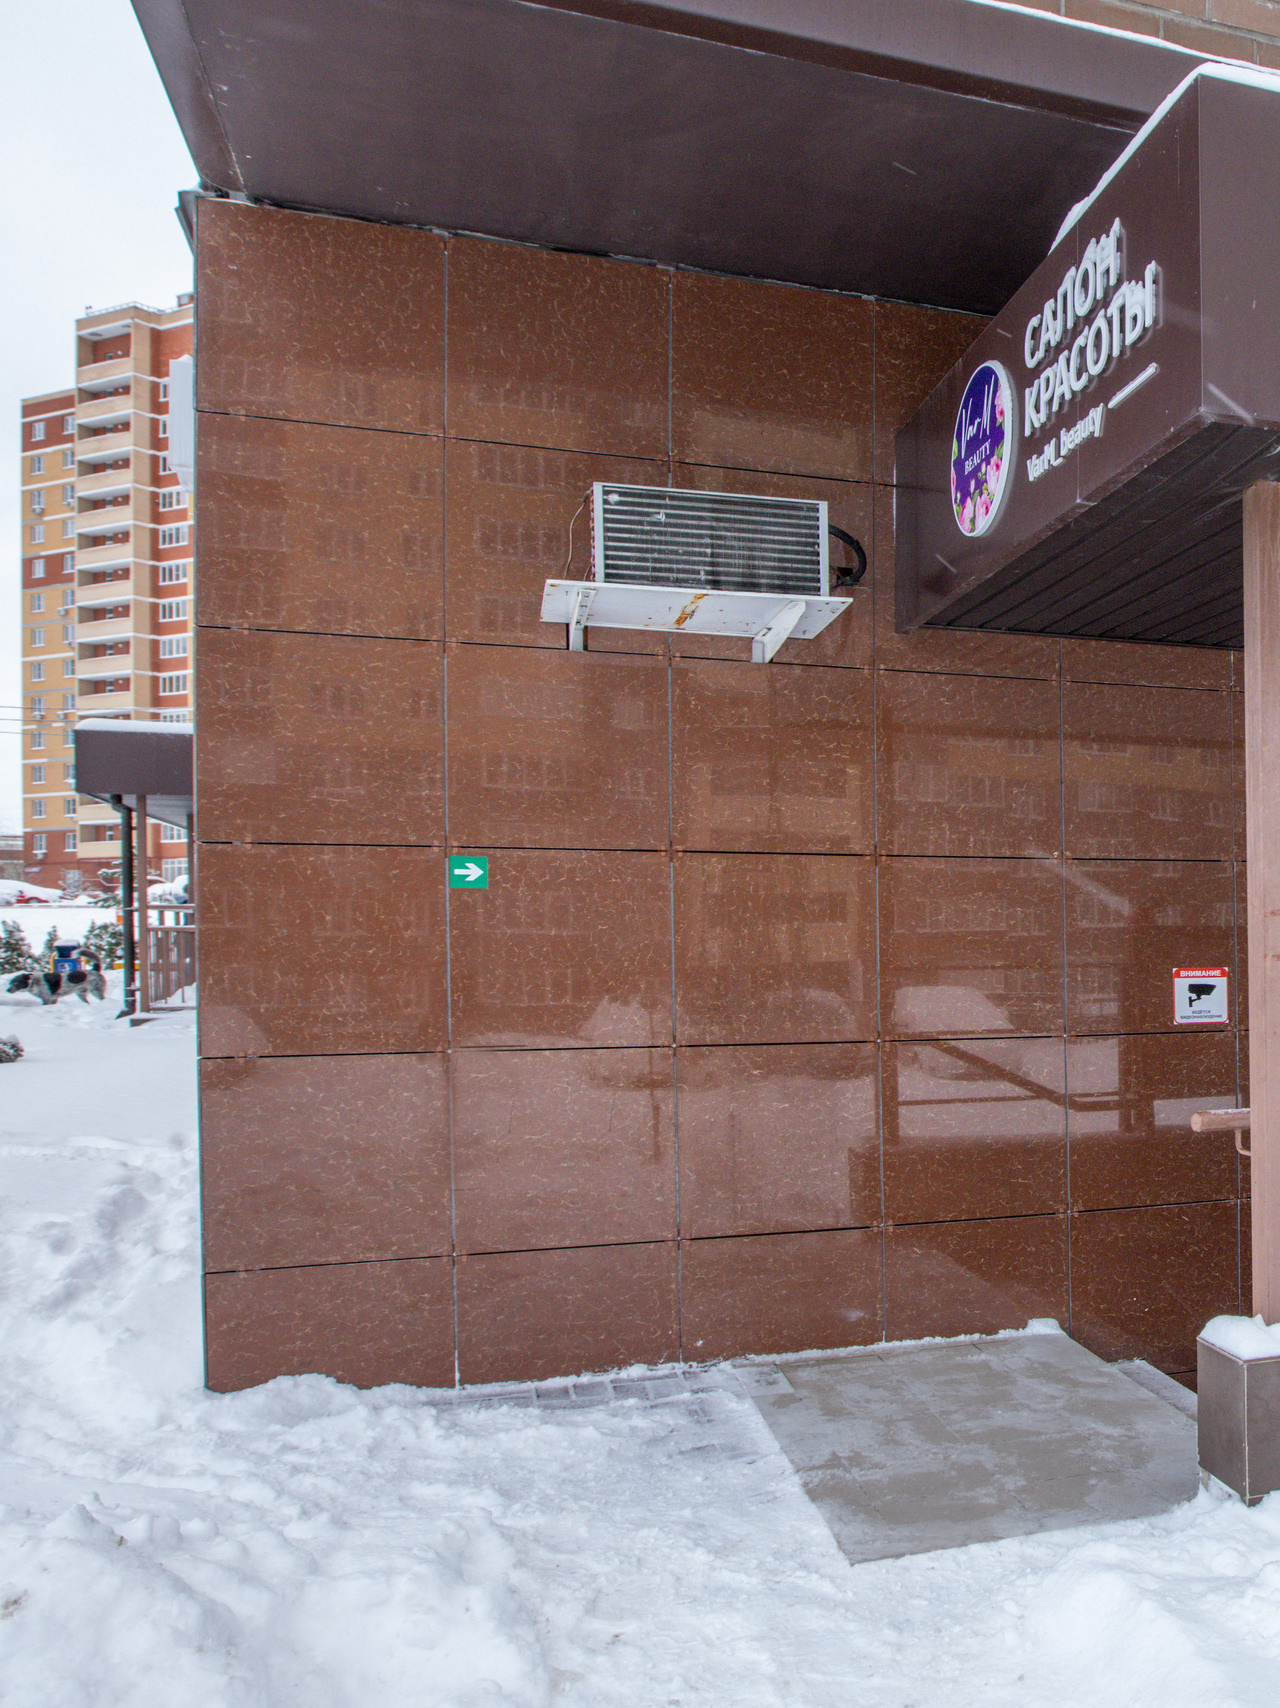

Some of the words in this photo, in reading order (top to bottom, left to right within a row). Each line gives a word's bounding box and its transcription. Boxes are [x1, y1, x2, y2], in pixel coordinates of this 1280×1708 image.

[1024, 220, 1119, 369] САЛОН
[1024, 262, 1156, 437] КРАСОТЫ
[964, 439, 991, 475] BEAUTY
